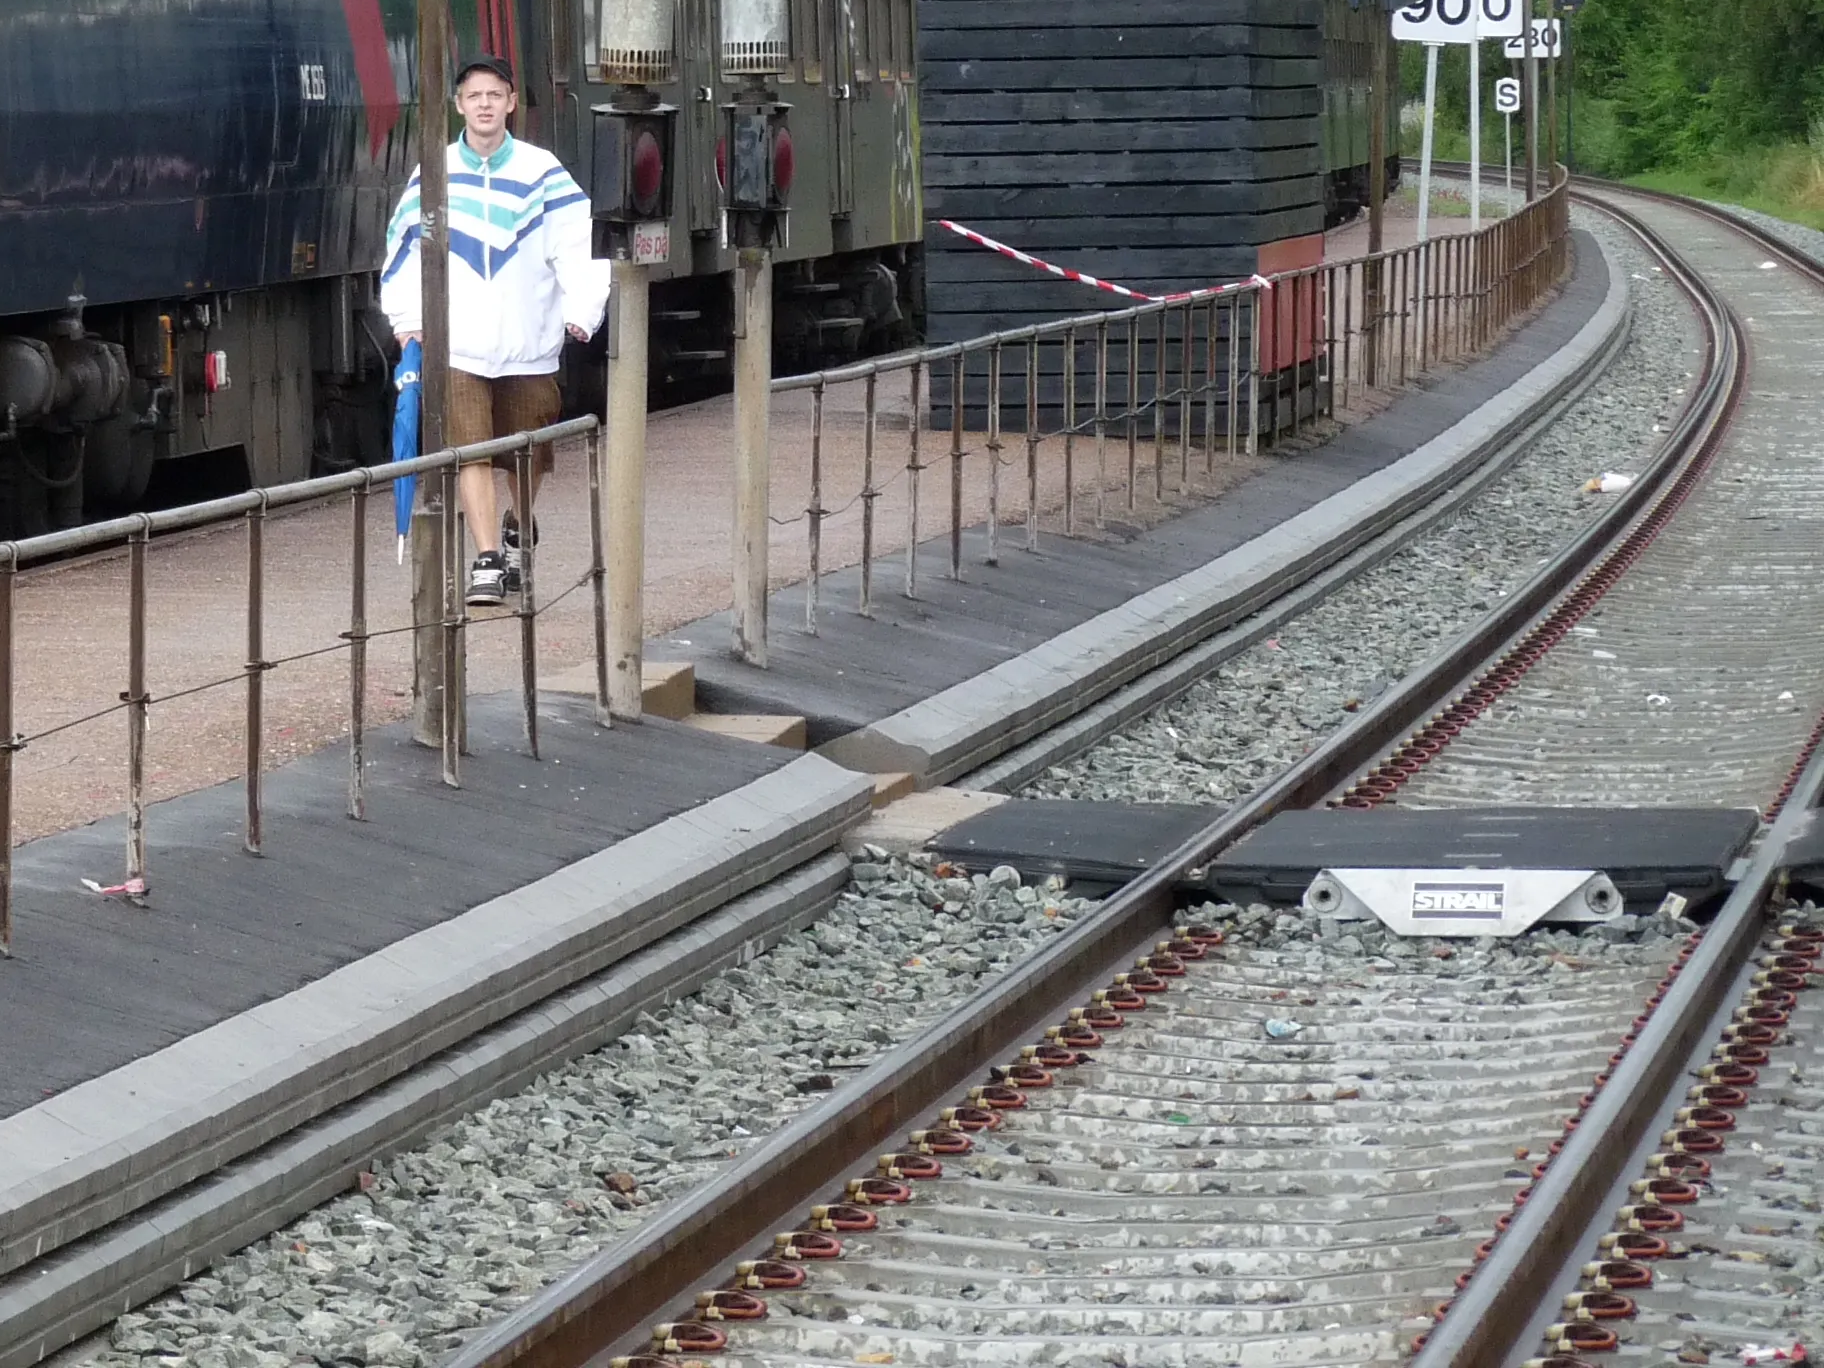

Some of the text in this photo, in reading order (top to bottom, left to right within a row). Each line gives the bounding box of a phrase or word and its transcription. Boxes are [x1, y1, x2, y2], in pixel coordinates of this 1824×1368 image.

[1498, 83, 1517, 107] S
[636, 232, 668, 259] Pas på
[1414, 892, 1503, 910] STRAIL
